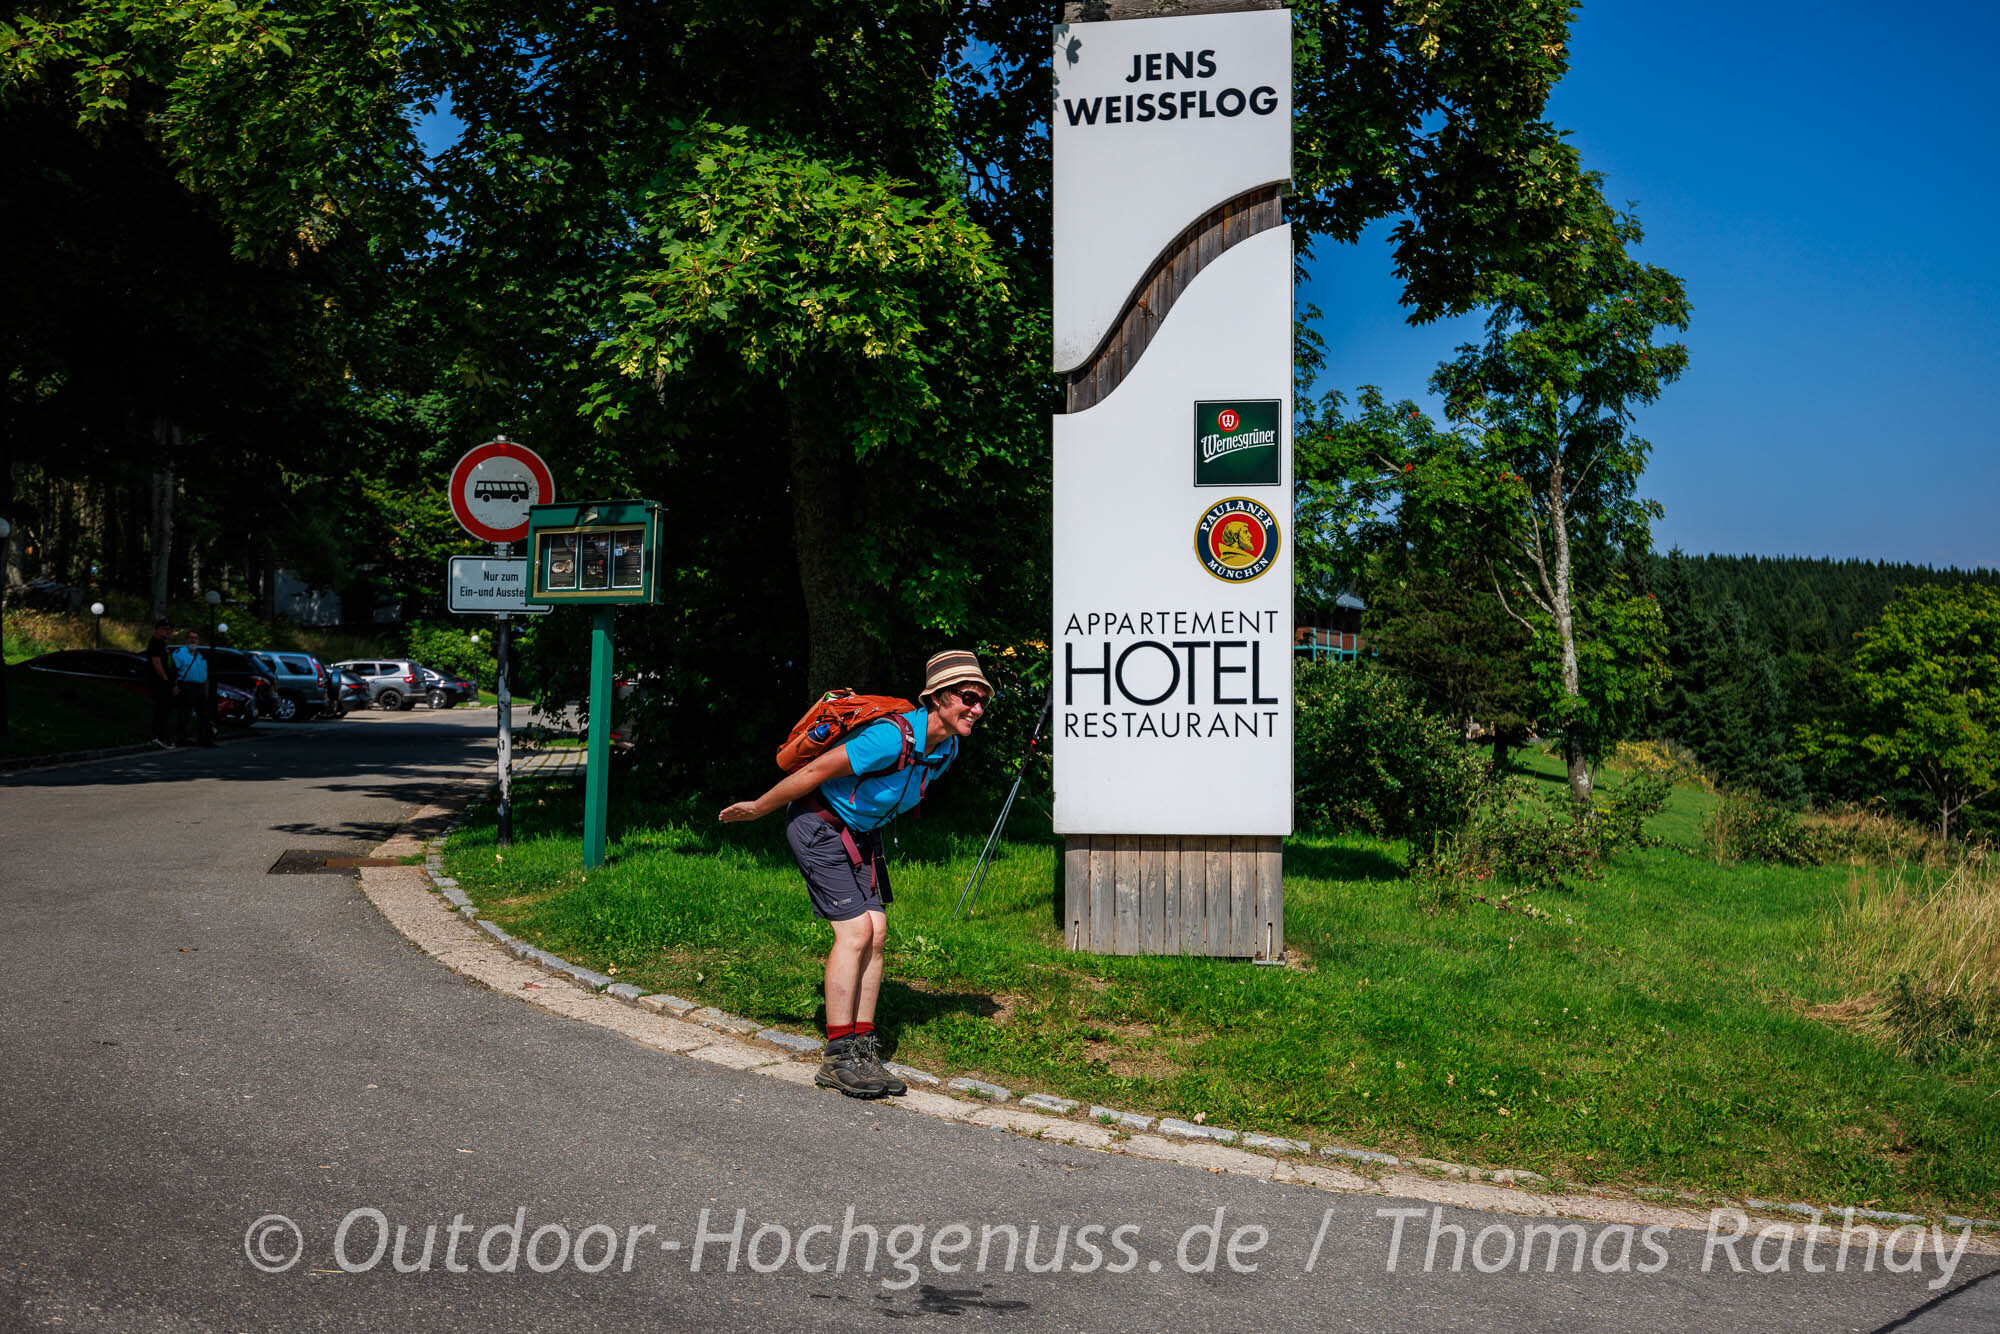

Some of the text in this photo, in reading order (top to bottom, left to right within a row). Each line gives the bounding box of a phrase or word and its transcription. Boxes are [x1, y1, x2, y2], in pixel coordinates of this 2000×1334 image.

[1125, 50, 1217, 83] JENS
[1063, 85, 1279, 127] WEISSFLOG
[1200, 428, 1275, 459] Wernesgrüner
[1200, 500, 1274, 532] PAULANER
[483, 570, 519, 582] Nur zum
[1207, 556, 1270, 580] MÜNCHEN
[460, 586, 494, 597] Ein-und
[1064, 610, 1279, 636] APPARTEMENT
[1065, 640, 1279, 706] HOTEL
[1065, 711, 1279, 738] RESTAURANT
